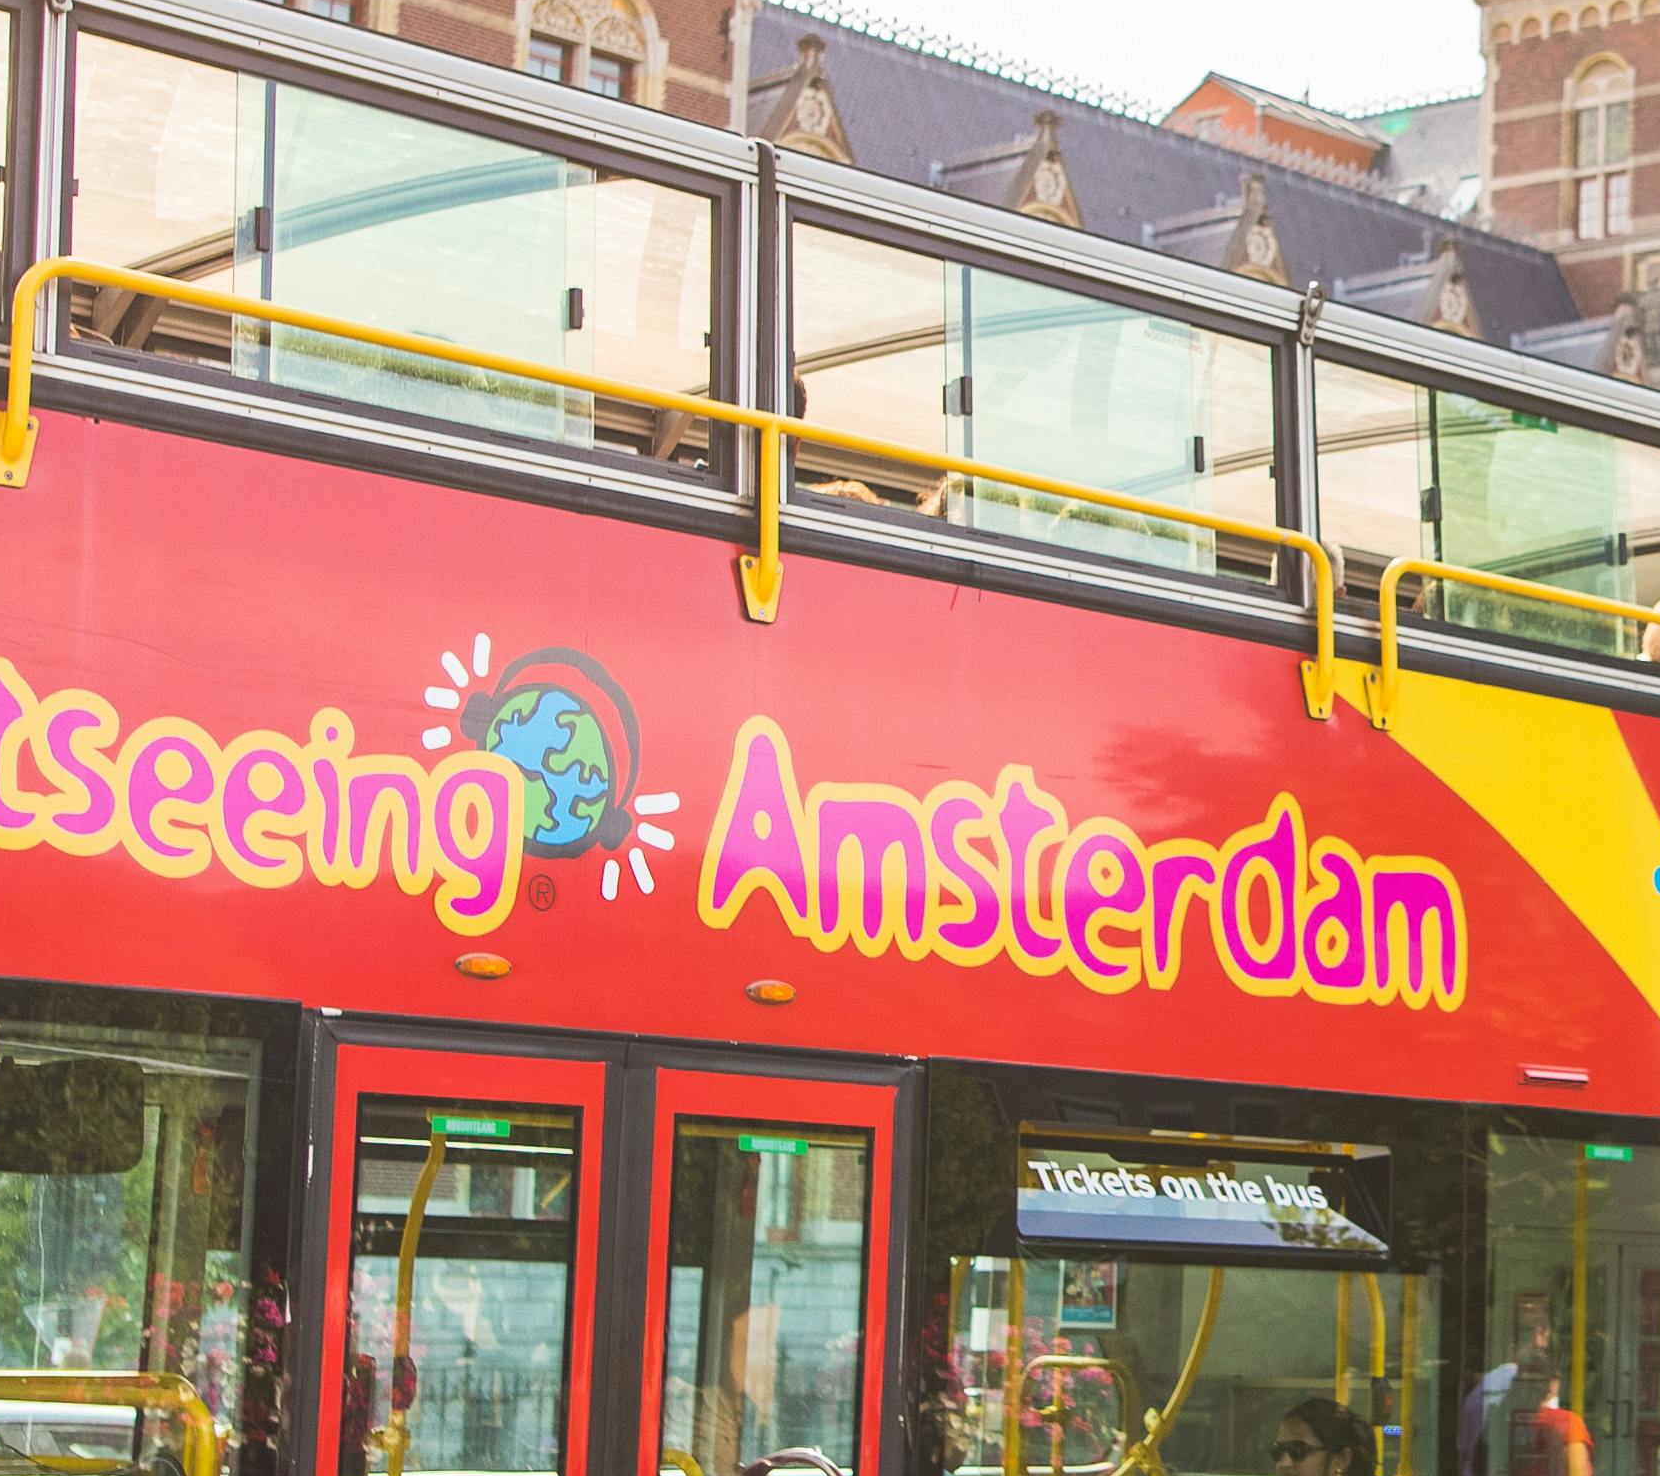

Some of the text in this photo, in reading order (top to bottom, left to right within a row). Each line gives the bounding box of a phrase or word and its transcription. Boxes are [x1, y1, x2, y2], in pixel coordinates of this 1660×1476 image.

[698, 714, 1468, 1013] Amsterdam
[1028, 1159, 1329, 1211] Tickets on the bus
